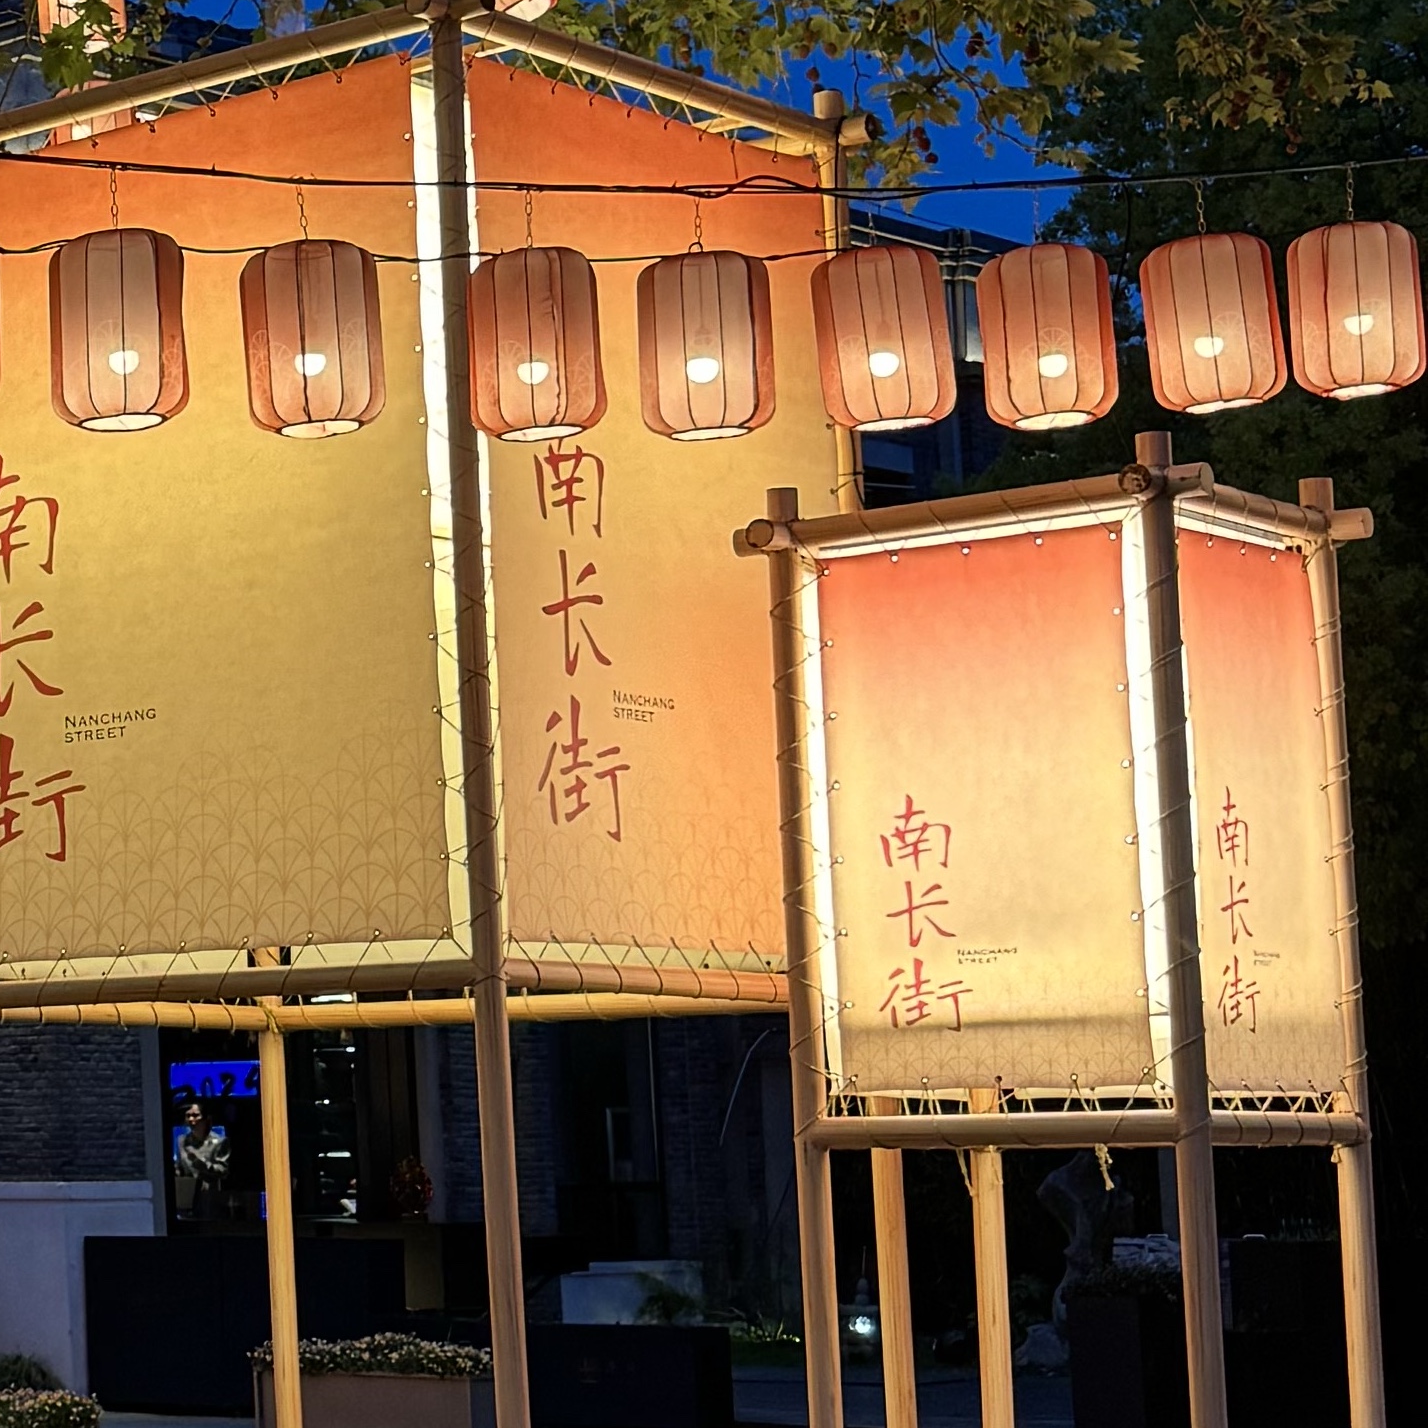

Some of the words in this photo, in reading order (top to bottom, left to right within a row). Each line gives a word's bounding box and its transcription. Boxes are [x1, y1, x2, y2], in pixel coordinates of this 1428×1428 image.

[533, 438, 632, 843] 南长街
[612, 689, 675, 710] NANCHANG
[64, 708, 157, 730] NANCHANG
[613, 707, 655, 723] STREET
[64, 726, 127, 744] STREET
[879, 794, 974, 1033] 南长街
[1216, 785, 1261, 1034] 南长街
